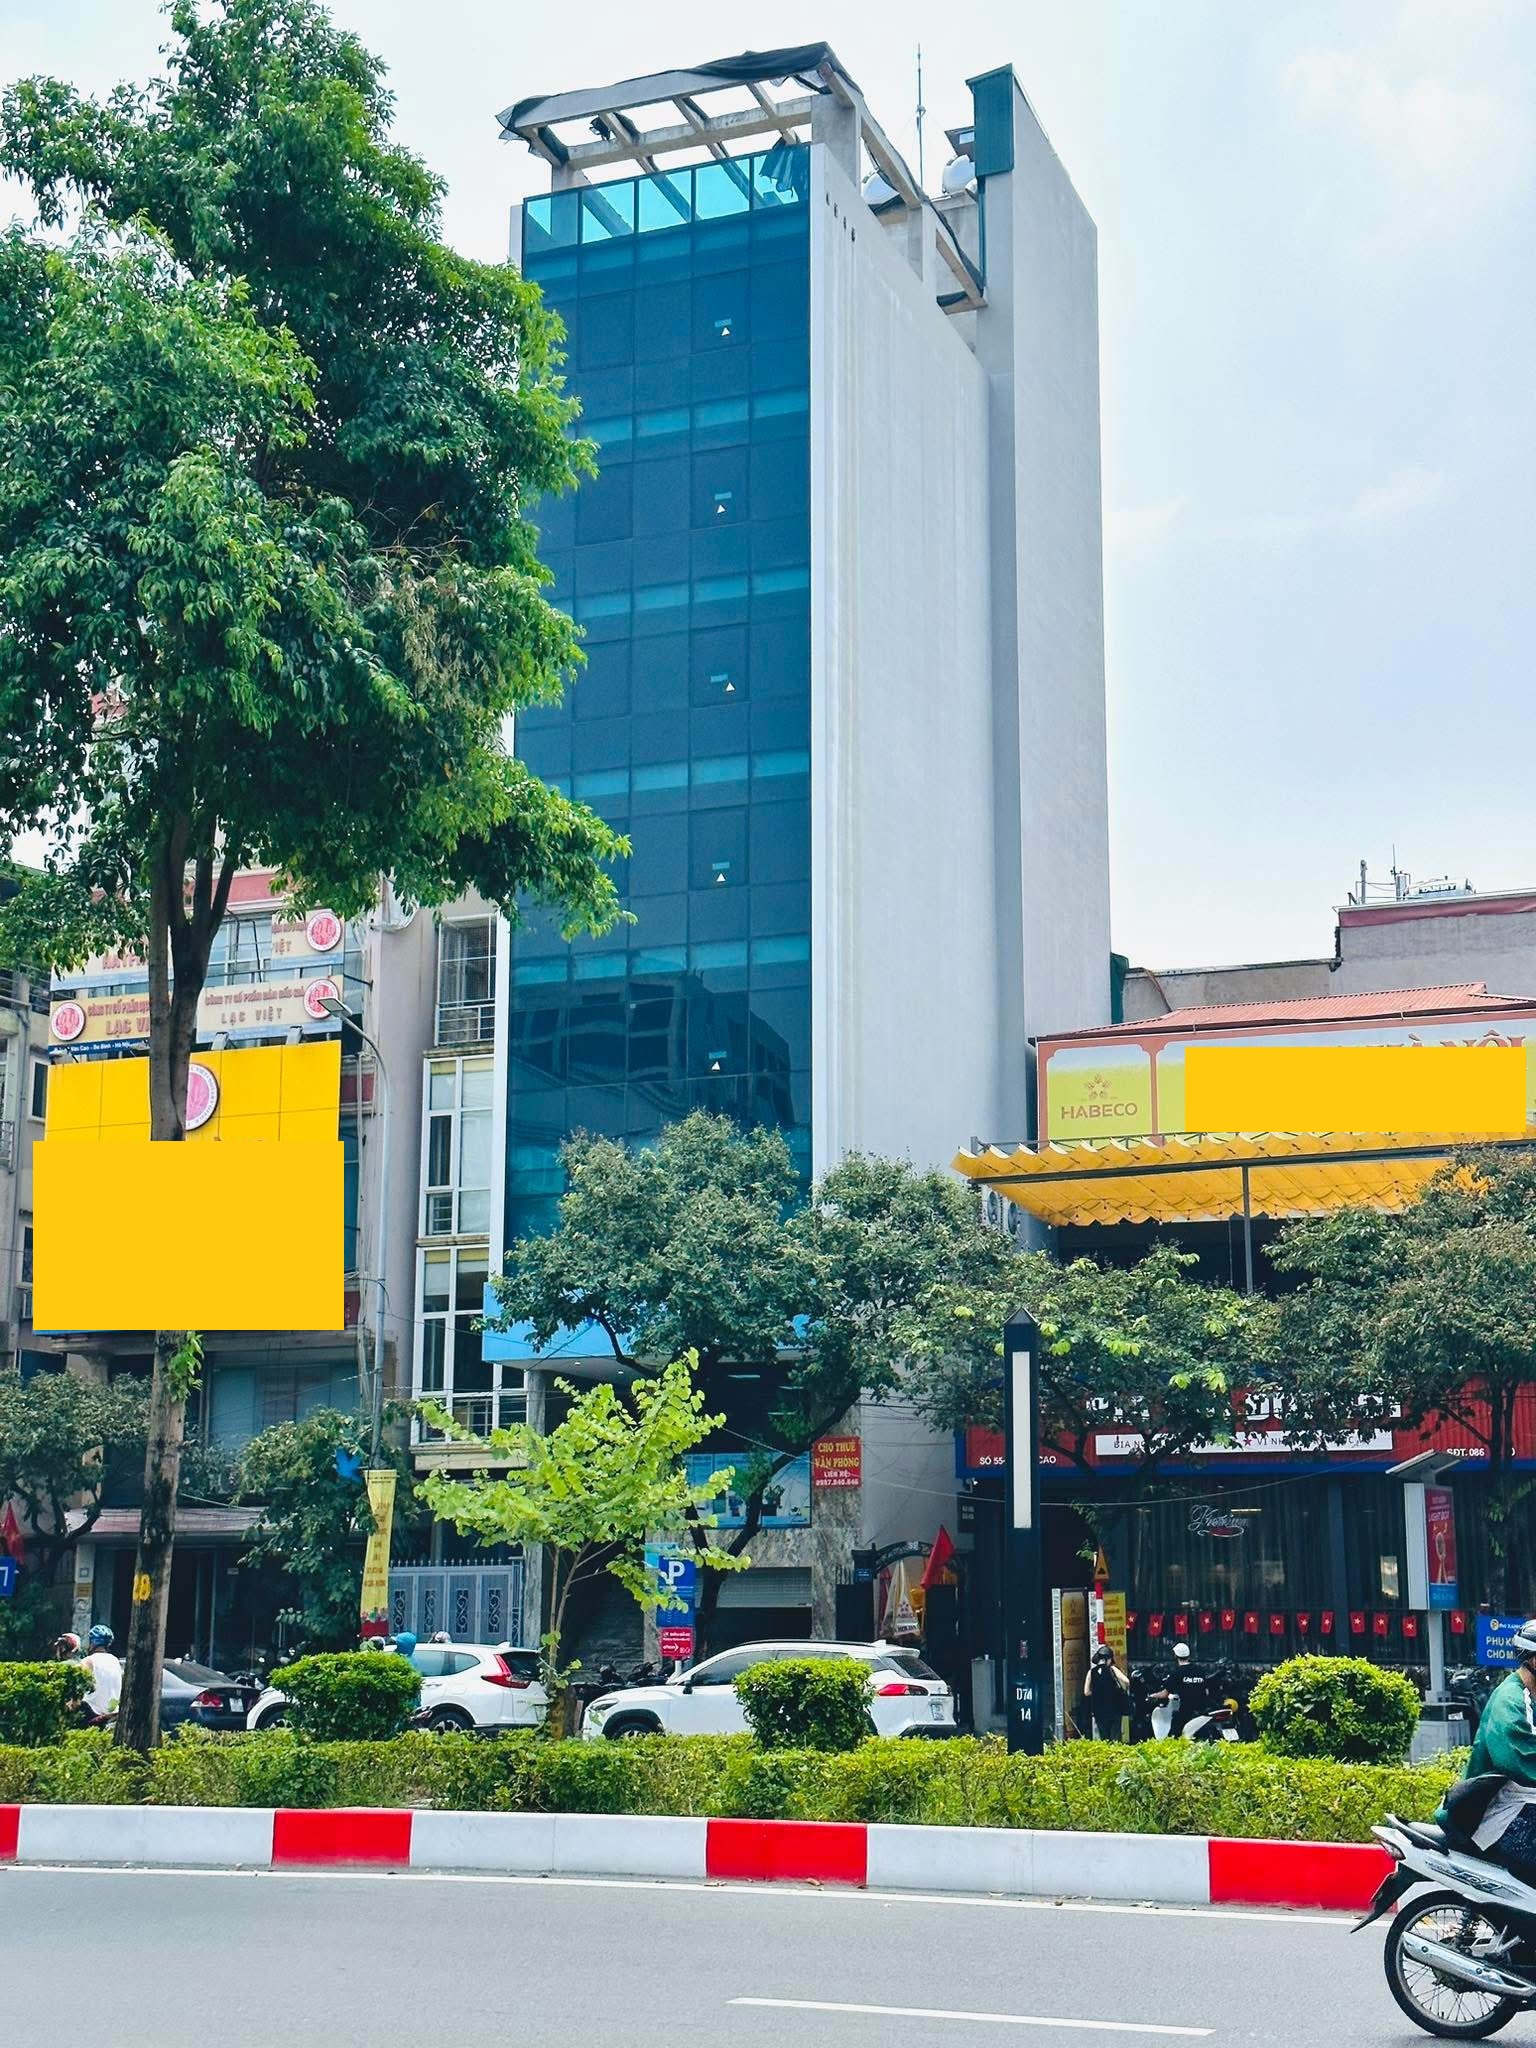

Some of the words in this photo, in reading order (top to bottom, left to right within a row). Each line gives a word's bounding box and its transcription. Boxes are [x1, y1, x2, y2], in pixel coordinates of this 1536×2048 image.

[273, 938, 292, 955] IỆT
[221, 1011, 246, 1025] LẠC
[256, 1006, 282, 1022] VIỆT
[106, 1019, 132, 1037] LẠC
[136, 1016, 149, 1033] VI
[1061, 1103, 1138, 1120] HABECO
[818, 1442, 834, 1453] CHO
[815, 1455, 831, 1468] VĂN
[833, 1455, 859, 1468] PHÒNG
[668, 1560, 686, 1585] P
[1487, 1648, 1506, 1659] CHO
[1020, 1708, 1031, 1721] 14
